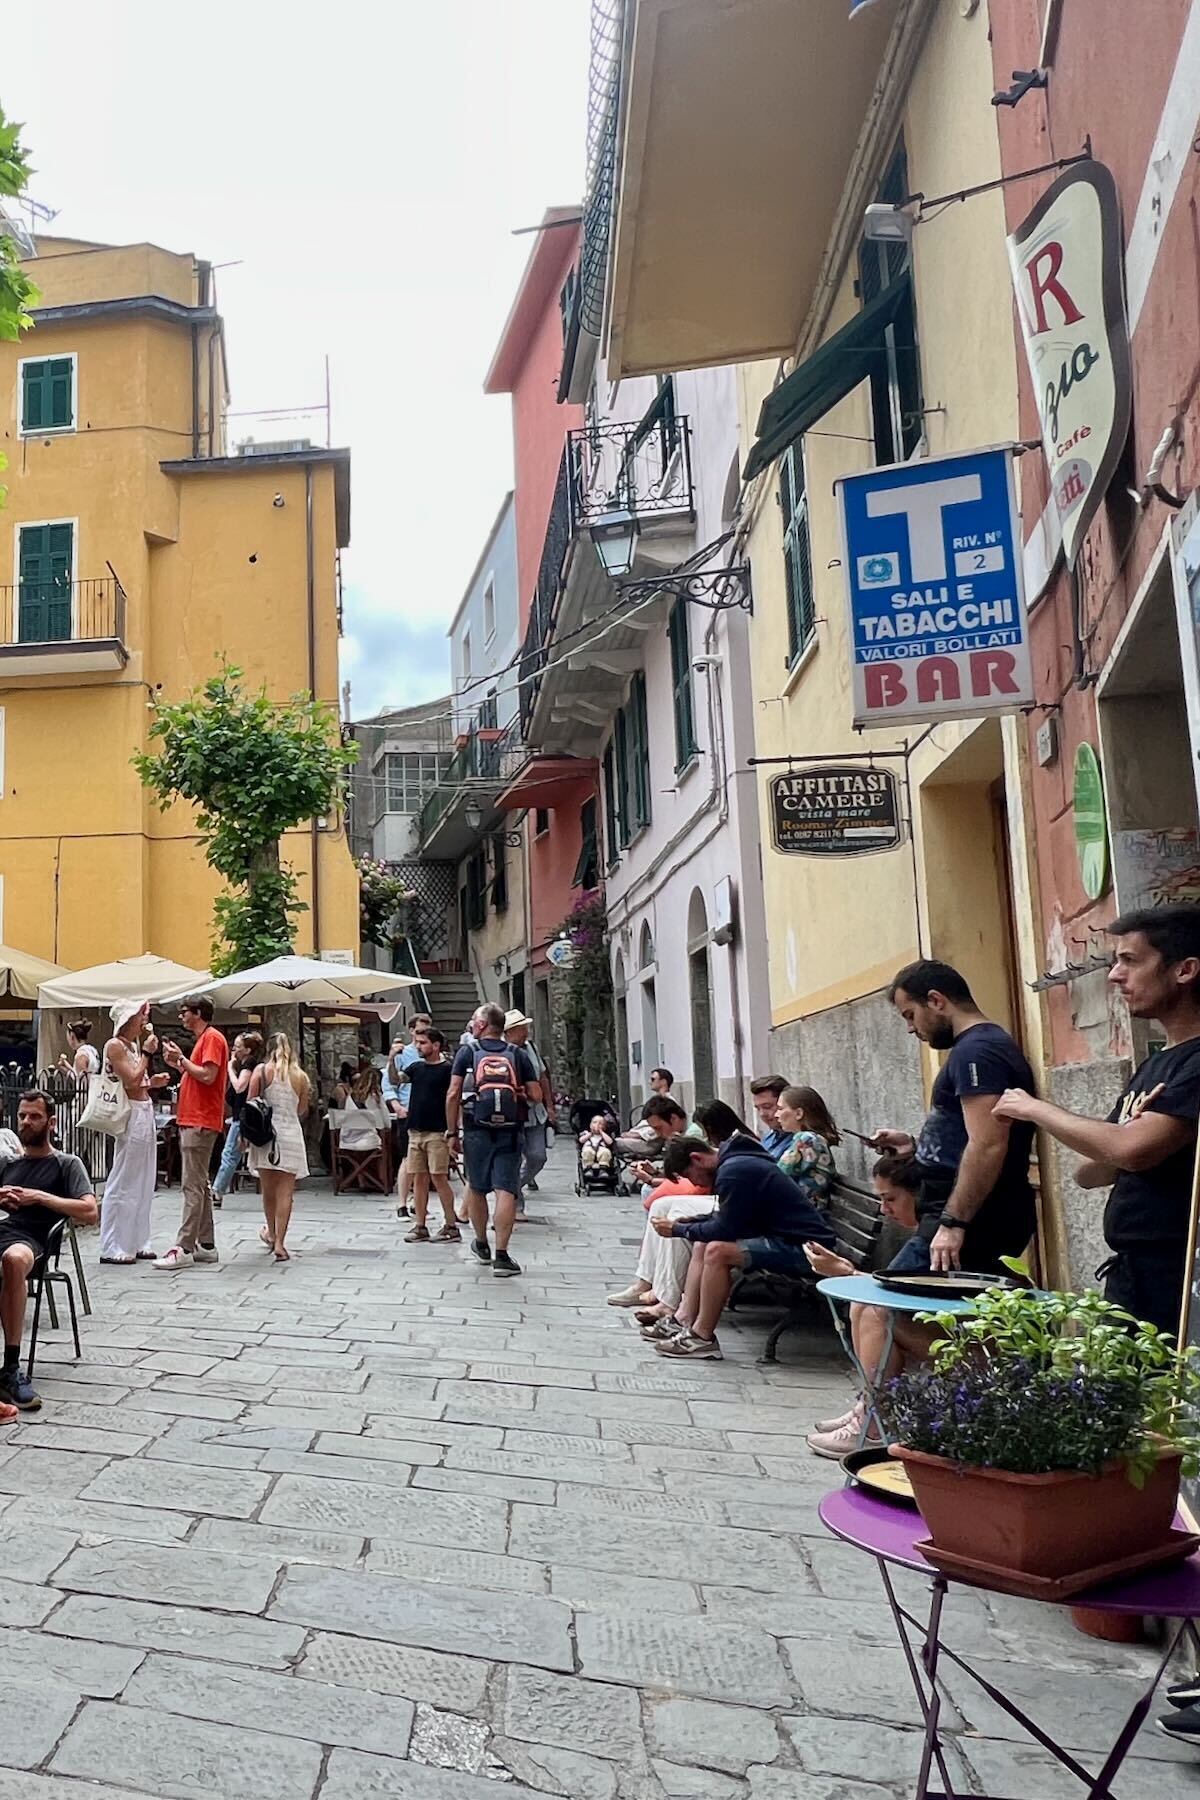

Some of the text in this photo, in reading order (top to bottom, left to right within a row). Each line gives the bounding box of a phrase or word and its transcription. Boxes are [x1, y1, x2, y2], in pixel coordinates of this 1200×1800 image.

[865, 473, 983, 584] T
[952, 535, 982, 549] RIV.
[973, 554, 987, 570] 2
[890, 583, 975, 609] SALI E
[859, 598, 1013, 641] TABACCHI
[860, 630, 1017, 662] VALORI BOLLATI
[863, 649, 1021, 709] BAR
[777, 775, 887, 796] AFFITTASI
[783, 793, 884, 810] CAMERE
[799, 808, 871, 818] vista mare
